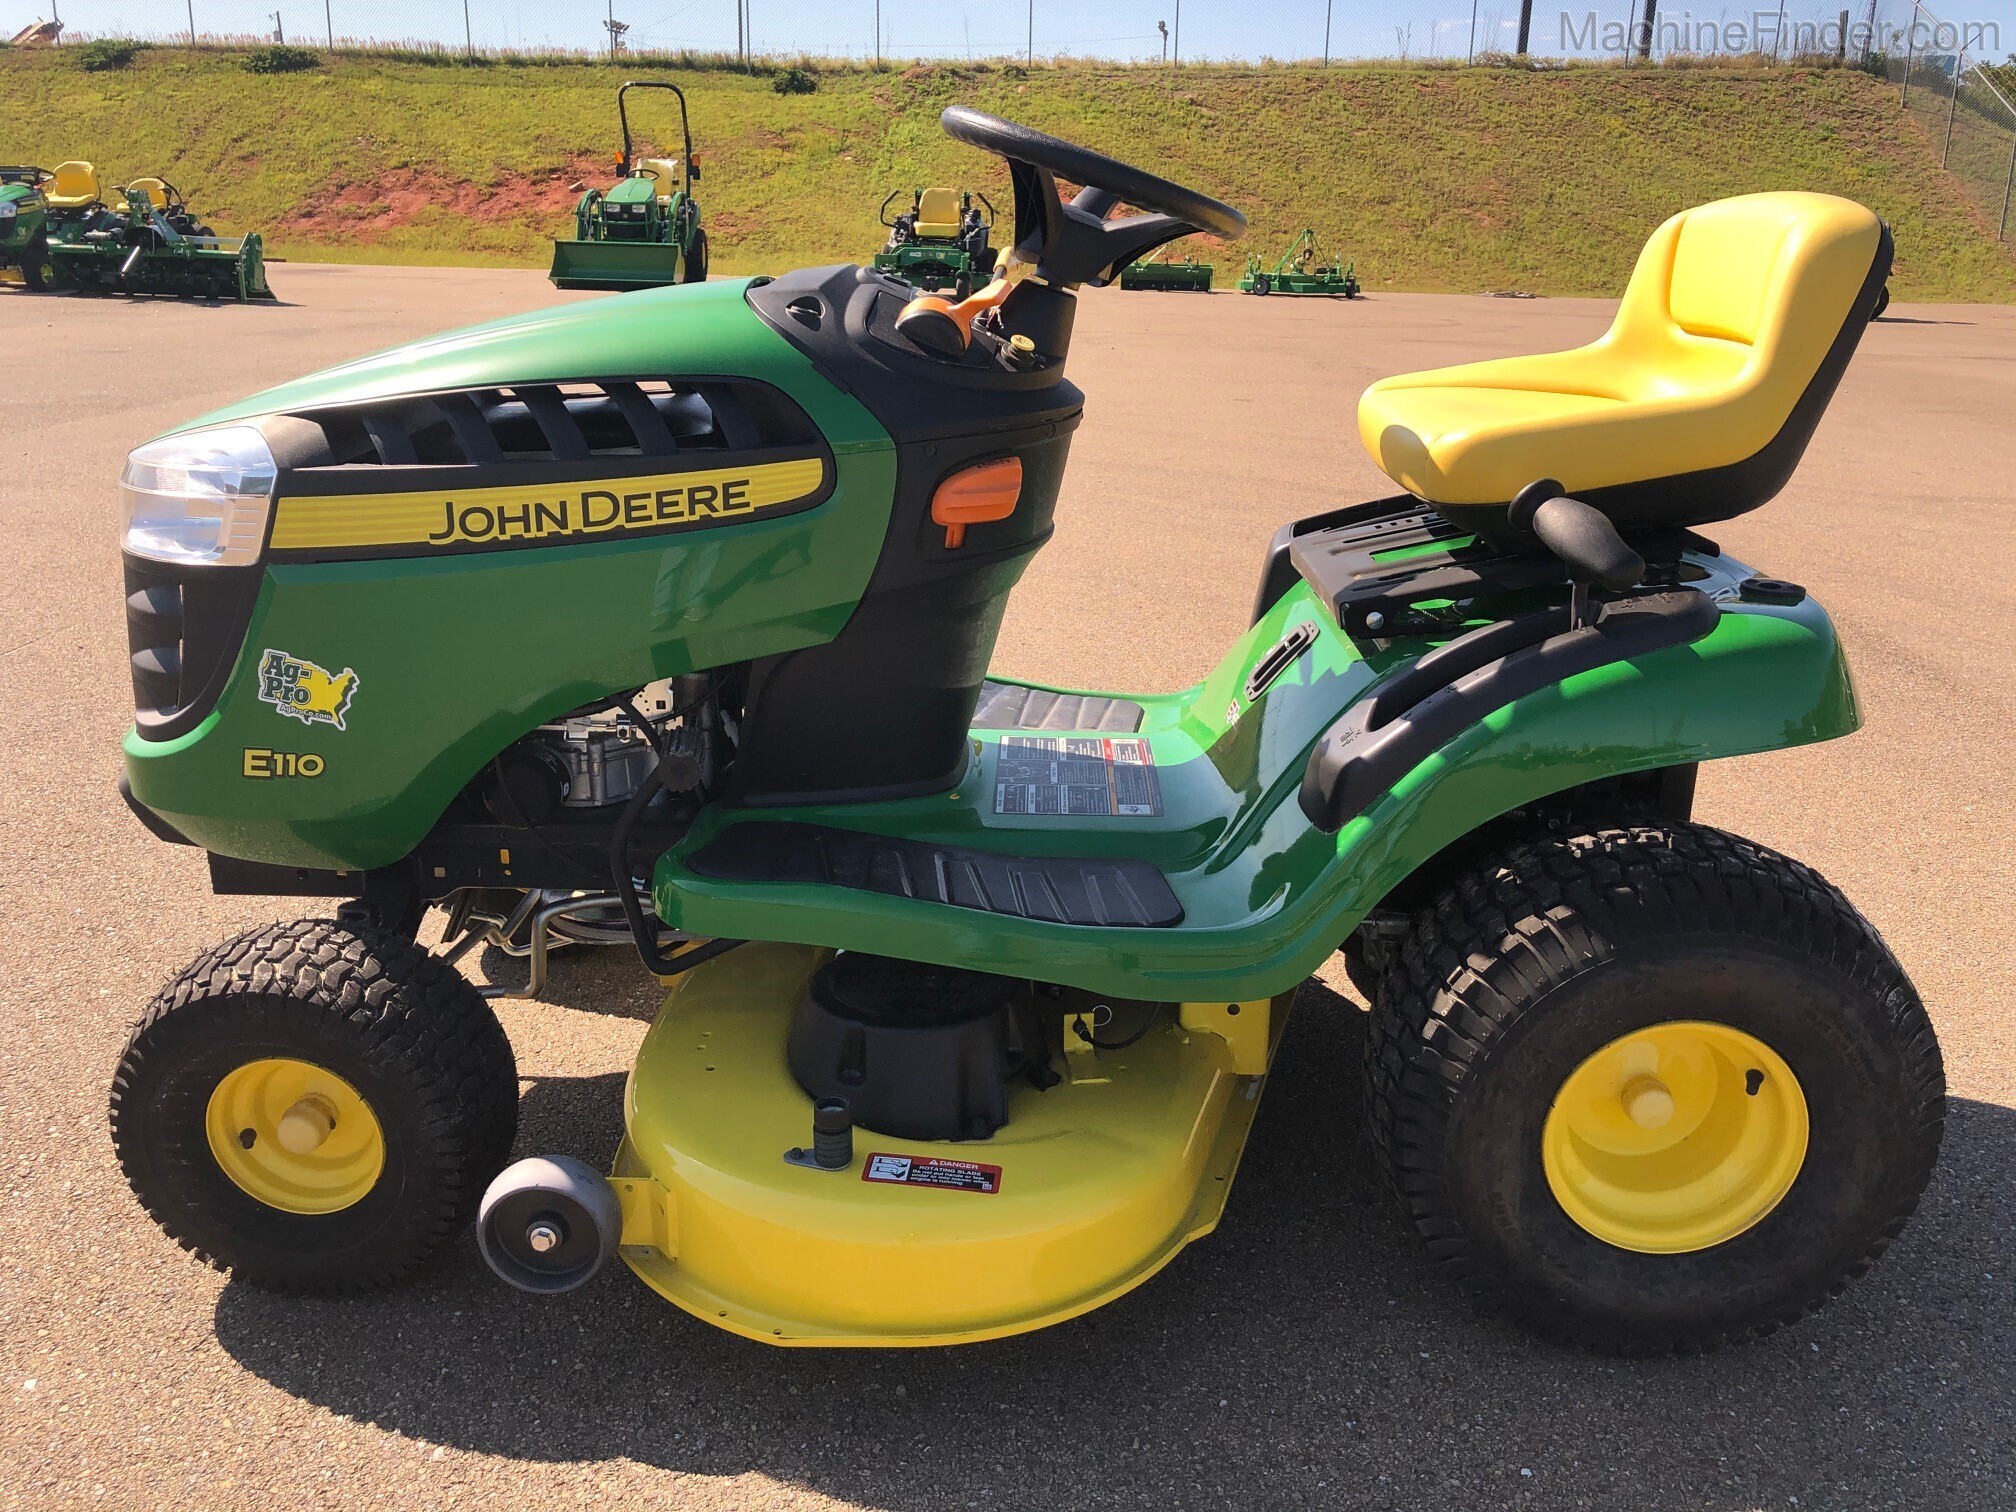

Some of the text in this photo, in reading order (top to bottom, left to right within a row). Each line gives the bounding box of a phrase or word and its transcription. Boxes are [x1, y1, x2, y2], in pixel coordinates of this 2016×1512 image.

[429, 479, 750, 541] JOHN DEERE
[263, 676, 311, 705] Pro
[279, 703, 333, 721] AgProCo.com
[244, 749, 324, 777] E110
[918, 1165, 956, 1173] ROTATING
[939, 1160, 979, 1170] DANGER
